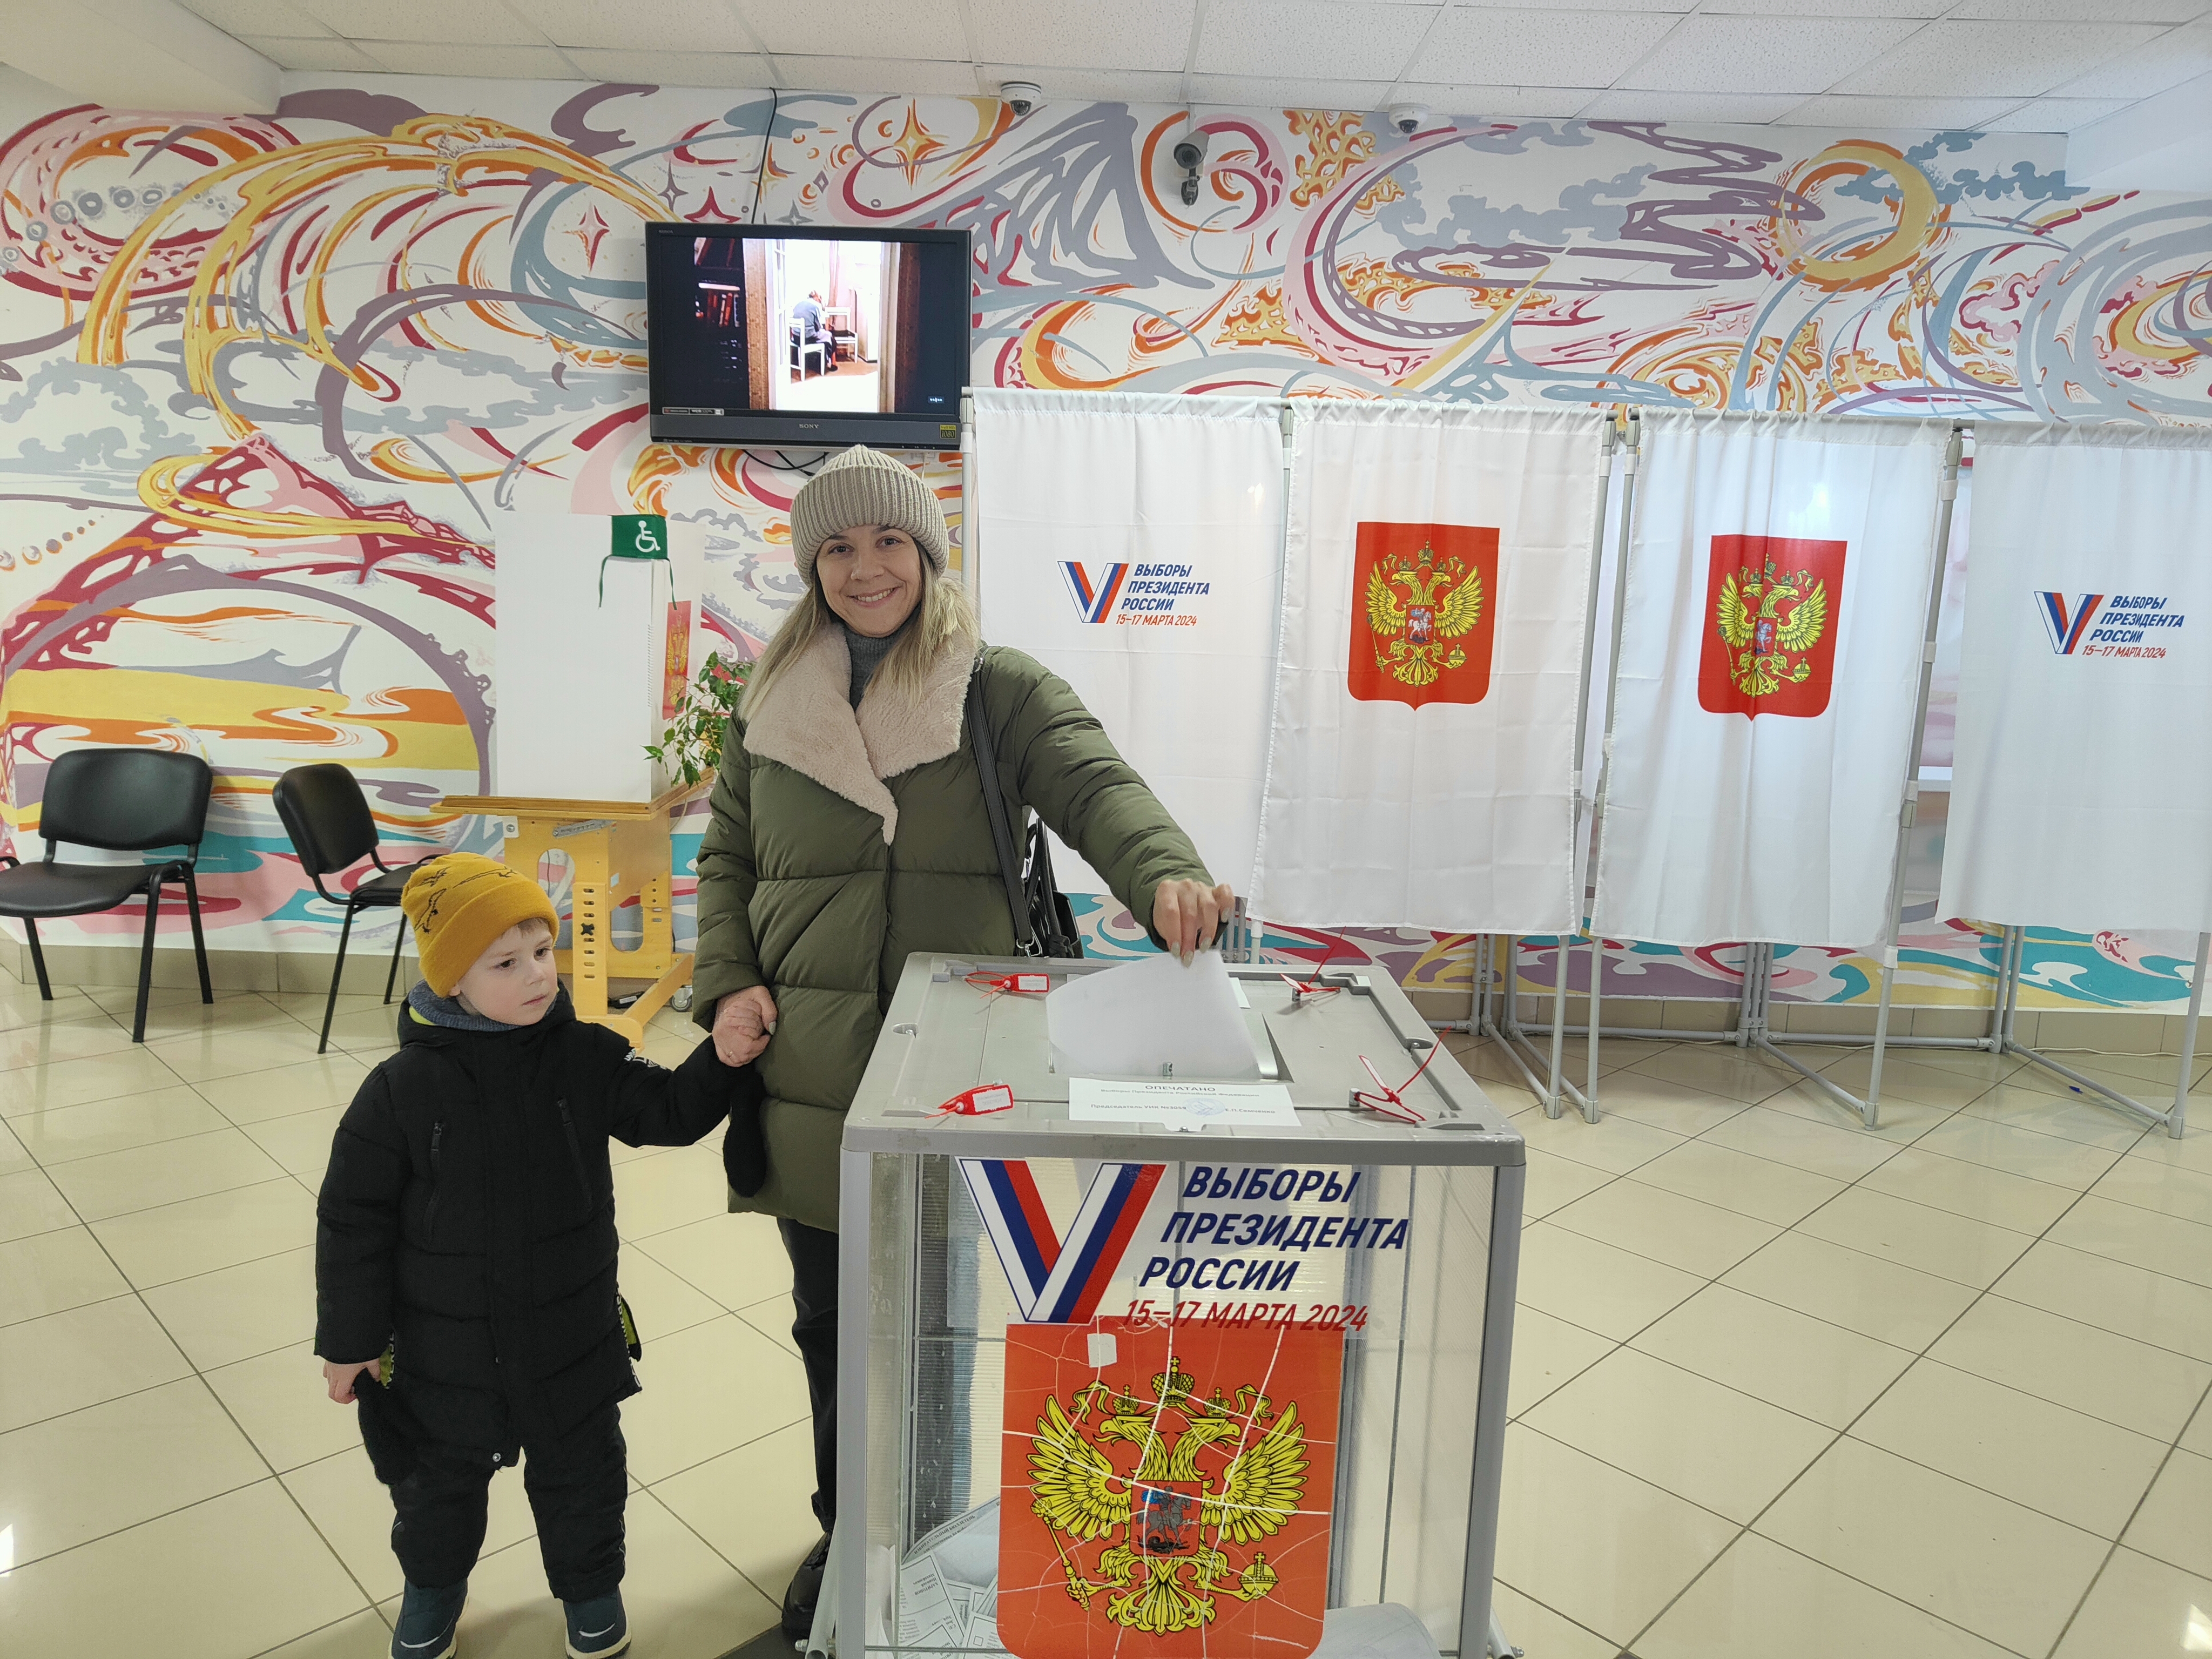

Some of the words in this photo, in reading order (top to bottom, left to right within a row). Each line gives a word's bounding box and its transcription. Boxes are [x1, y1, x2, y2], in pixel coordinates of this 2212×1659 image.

[1134, 564, 1192, 577] ВЫБОРЫ
[1127, 581, 1210, 596] ПРЕЗИДЕНТА
[1121, 598, 1175, 611] РОССИИ
[2109, 595, 2168, 610] ВЫБОРЫ
[1142, 615, 1174, 626] МАРТА
[1174, 615, 1198, 626] 2024
[2099, 612, 2185, 628] ПРЕЗИДЕНТА
[2089, 629, 2144, 643] РОССИИ
[2114, 646, 2142, 658] МАРТА
[2141, 647, 2167, 658] 2024
[1183, 1166, 1360, 1203] ВЫБОРЫ
[1161, 1211, 1410, 1252] ПРЕЗИДЕНТА
[1139, 1256, 1300, 1291] РОССИИ
[1199, 1301, 1296, 1331] МАРТА
[1299, 1304, 1369, 1332] 2024
